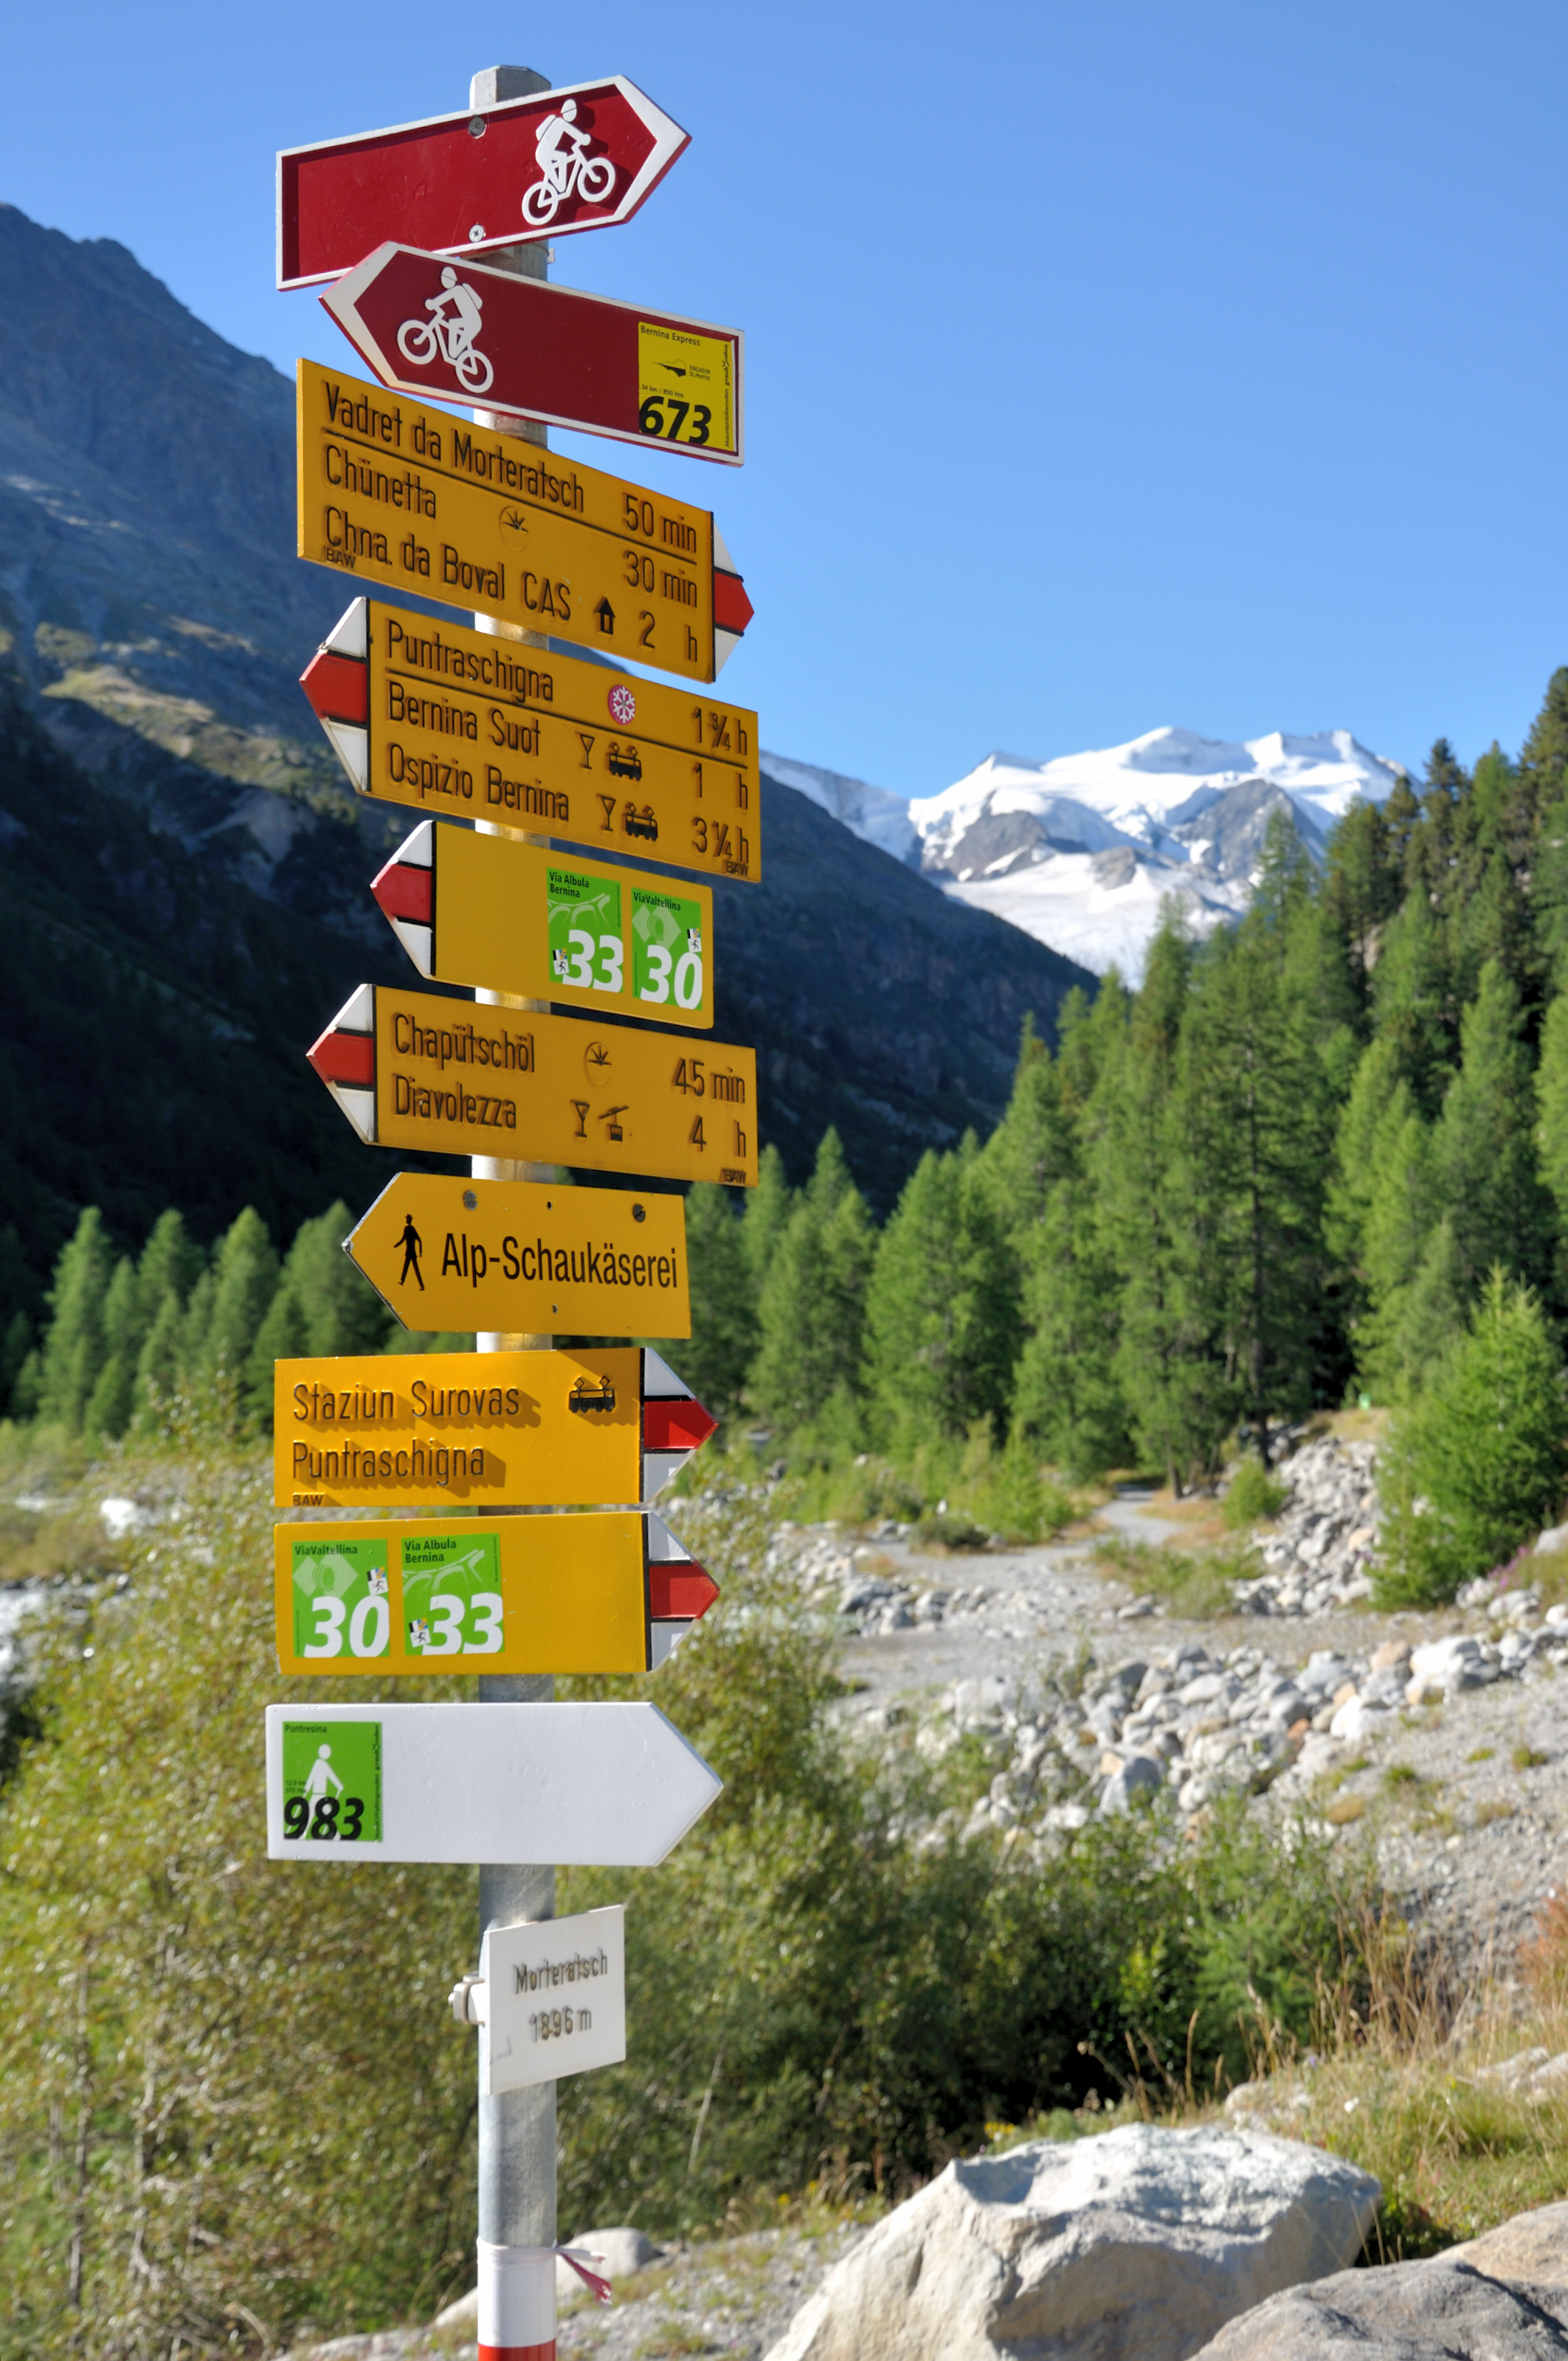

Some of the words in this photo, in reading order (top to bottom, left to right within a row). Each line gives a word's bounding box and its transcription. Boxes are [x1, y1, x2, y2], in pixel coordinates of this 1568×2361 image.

[640, 325, 669, 339] Bernina
[672, 333, 700, 346] Express
[689, 365, 711, 374] ENGADIN
[639, 395, 711, 445] 673
[322, 380, 402, 446] Vadret
[412, 416, 441, 461] da
[452, 429, 583, 513] Morteratsch
[623, 492, 654, 537] 50
[661, 515, 697, 553] min
[325, 445, 436, 519] Chünetta
[623, 550, 655, 592] 30
[662, 570, 697, 608] min
[326, 549, 356, 569] BAW
[401, 533, 430, 577] da
[441, 543, 505, 601] Boval
[522, 572, 571, 621] CAS
[640, 611, 655, 649] 2
[685, 624, 697, 663] h
[386, 618, 553, 703] Puntraschigna
[736, 718, 747, 756] h
[387, 680, 477, 741] Bernina
[488, 708, 541, 756] Suot
[693, 762, 702, 798] 1
[736, 772, 748, 810] h
[388, 744, 473, 799] Ospizio
[485, 764, 569, 822] Bernina
[737, 826, 749, 864] h
[549, 871, 562, 882] Via
[564, 874, 589, 888] Albula
[550, 883, 580, 898] Bernina
[725, 861, 748, 877] BAW
[562, 929, 624, 993] 33
[640, 944, 702, 1010] 30
[393, 1012, 534, 1073] Chapütschöl
[673, 1057, 705, 1096] 45
[710, 1067, 745, 1104] min
[393, 1074, 517, 1130] Diavolezza
[689, 1115, 707, 1152] 4
[733, 1120, 746, 1158] h
[723, 1169, 747, 1184] BAW
[441, 1232, 677, 1288] Alp-Schaukäserei
[293, 1382, 394, 1421] Staziun
[411, 1379, 519, 1418] Surovas
[293, 1437, 484, 1487] Puntraschigna
[292, 1493, 323, 1507] BAW
[404, 1541, 421, 1551] Via
[424, 1539, 456, 1550] Albula
[405, 1553, 444, 1563] Bernina
[303, 1595, 390, 1658] 30
[421, 1592, 503, 1655] 33
[285, 1724, 327, 1734] Pontresina
[284, 1797, 365, 1840] 983
[514, 1948, 607, 1995] Morteratsch
[530, 2006, 573, 2043] 1896
[578, 2008, 592, 2032] m
